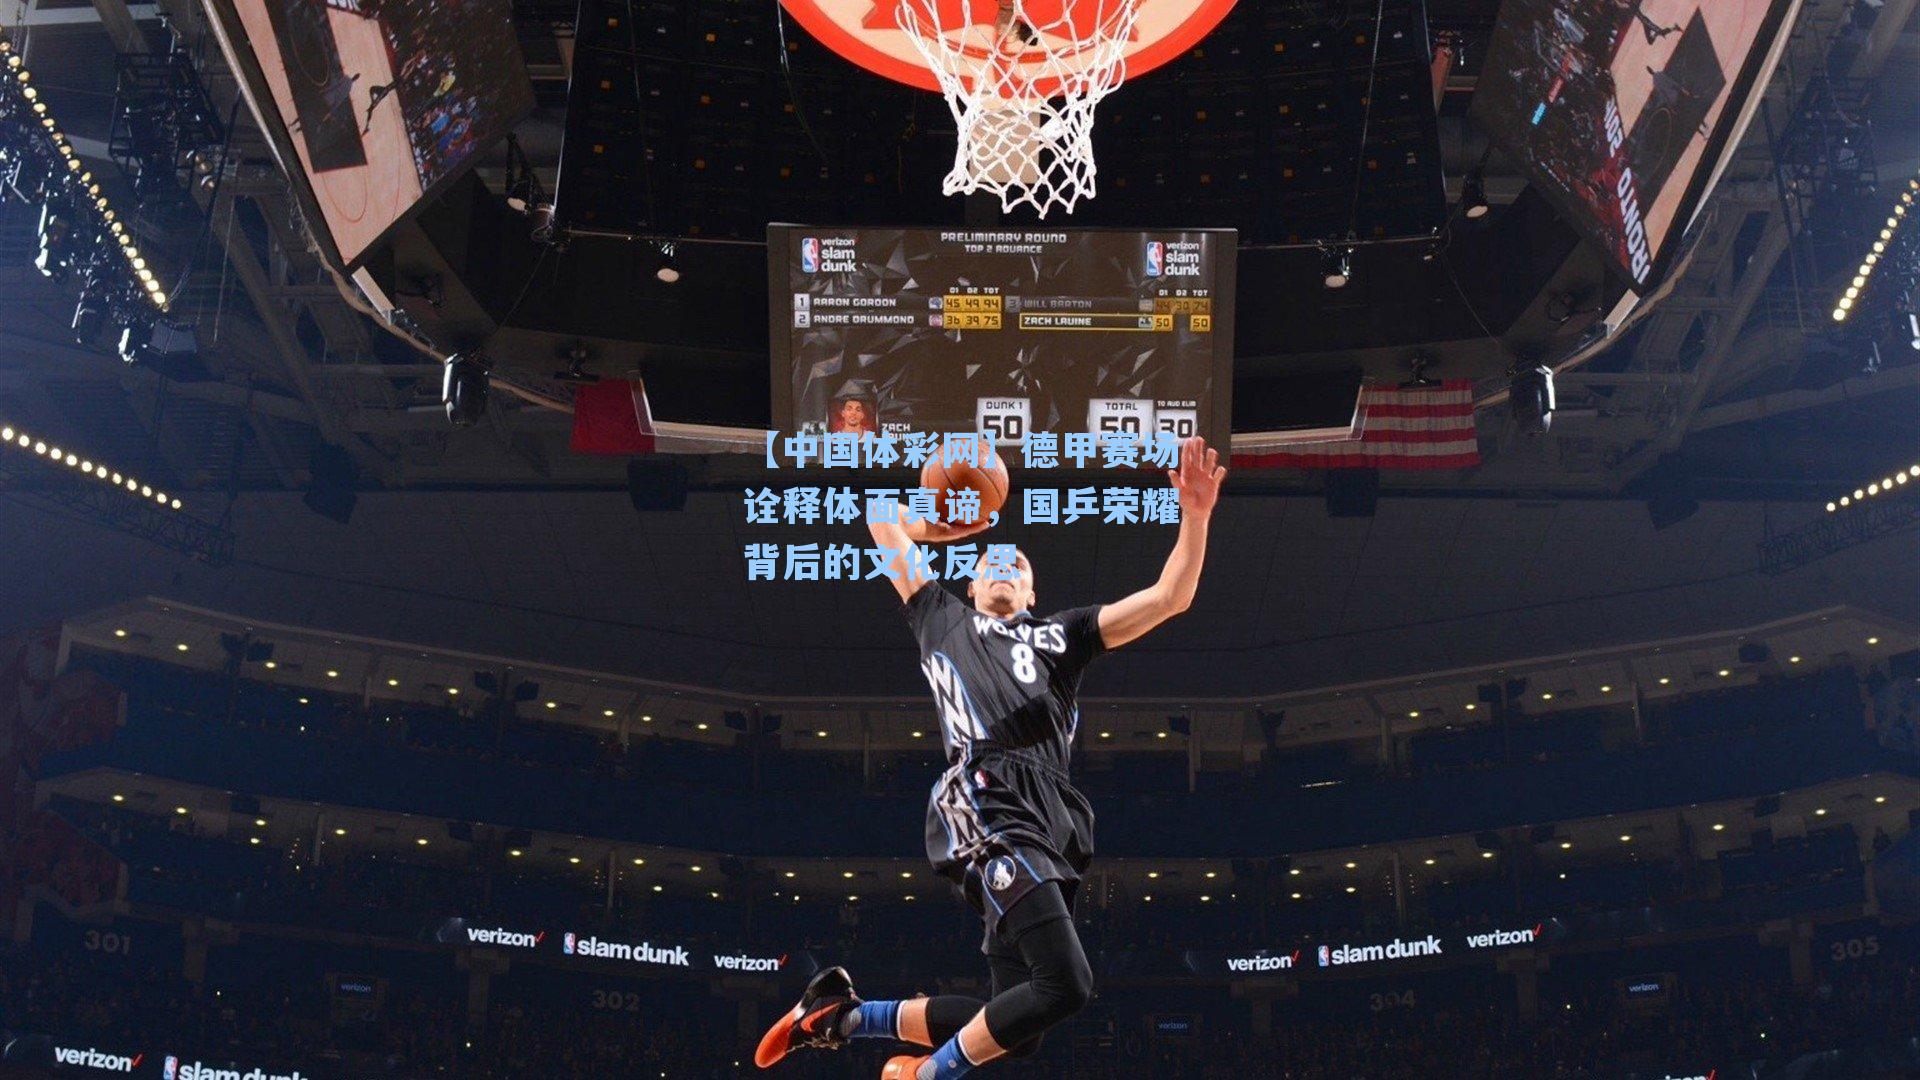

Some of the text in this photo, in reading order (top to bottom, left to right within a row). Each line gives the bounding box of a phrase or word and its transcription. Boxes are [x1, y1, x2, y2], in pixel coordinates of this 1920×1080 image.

[821, 237, 855, 246] verizon
[940, 232, 1067, 243] PRELIMINARY ROUND
[965, 244, 1043, 254] TOP 2 ADVANCE
[1166, 242, 1199, 250] verizon
[821, 246, 855, 259] slam
[1165, 251, 1199, 263] slam
[821, 260, 857, 272] dunk
[1164, 264, 1200, 276] dunk
[813, 298, 850, 307] AARON
[853, 298, 897, 307] GORDON
[946, 299, 960, 308] 45
[965, 299, 980, 308] 49
[983, 299, 999, 308] 94
[1024, 299, 1047, 308] WILL
[1050, 299, 1092, 309] BARTON
[798, 314, 807, 325] 2
[813, 315, 850, 324] ANDRE
[852, 315, 915, 325] DRUMMOND
[965, 316, 980, 325] 39
[983, 316, 999, 325] 75
[1024, 317, 1208, 327] ZACH LAVINE 50 50
[986, 401, 1023, 410] DUNK 1
[1105, 402, 1139, 411] TOTAL
[881, 423, 911, 432] ZACH
[983, 415, 1023, 440] 50
[1100, 416, 1140, 440] 50
[1011, 643, 1037, 683] 8
[85, 929, 132, 955] 301
[467, 927, 535, 947] verizon
[1466, 929, 1534, 948] verizon
[577, 937, 690, 966] slam dunk
[1331, 935, 1443, 965] slam dunk
[1830, 935, 1880, 960] 305
[714, 954, 779, 971] verizon
[1227, 953, 1291, 971] verizon
[55, 1046, 132, 1072] verizon
[178, 1061, 242, 1080] slam
